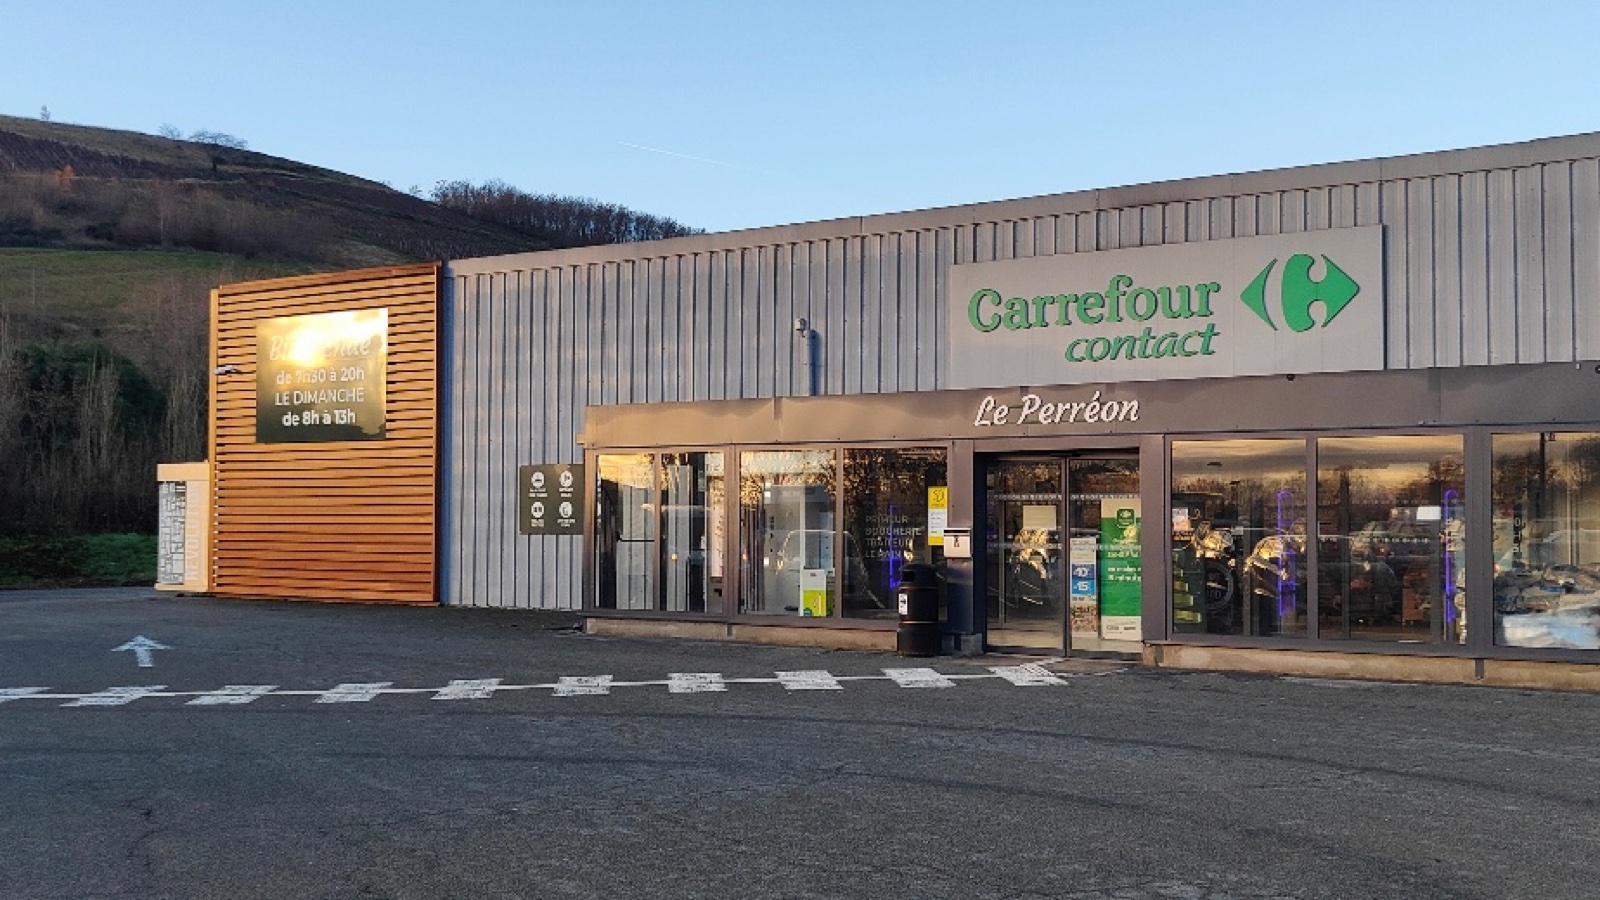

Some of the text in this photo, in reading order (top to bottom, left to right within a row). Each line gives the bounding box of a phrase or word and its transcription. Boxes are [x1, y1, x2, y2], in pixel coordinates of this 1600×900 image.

[968, 274, 1221, 333] Carrefour
[1064, 322, 1220, 363] contact
[276, 366, 365, 385] de 7h30 à 20h
[275, 386, 365, 406] LE DIMANCHE
[282, 407, 356, 427] de 8h à 13h
[973, 391, 1140, 427] Le Perréon
[865, 527, 922, 536] BOUCHERIE
[865, 549, 876, 558] LE
